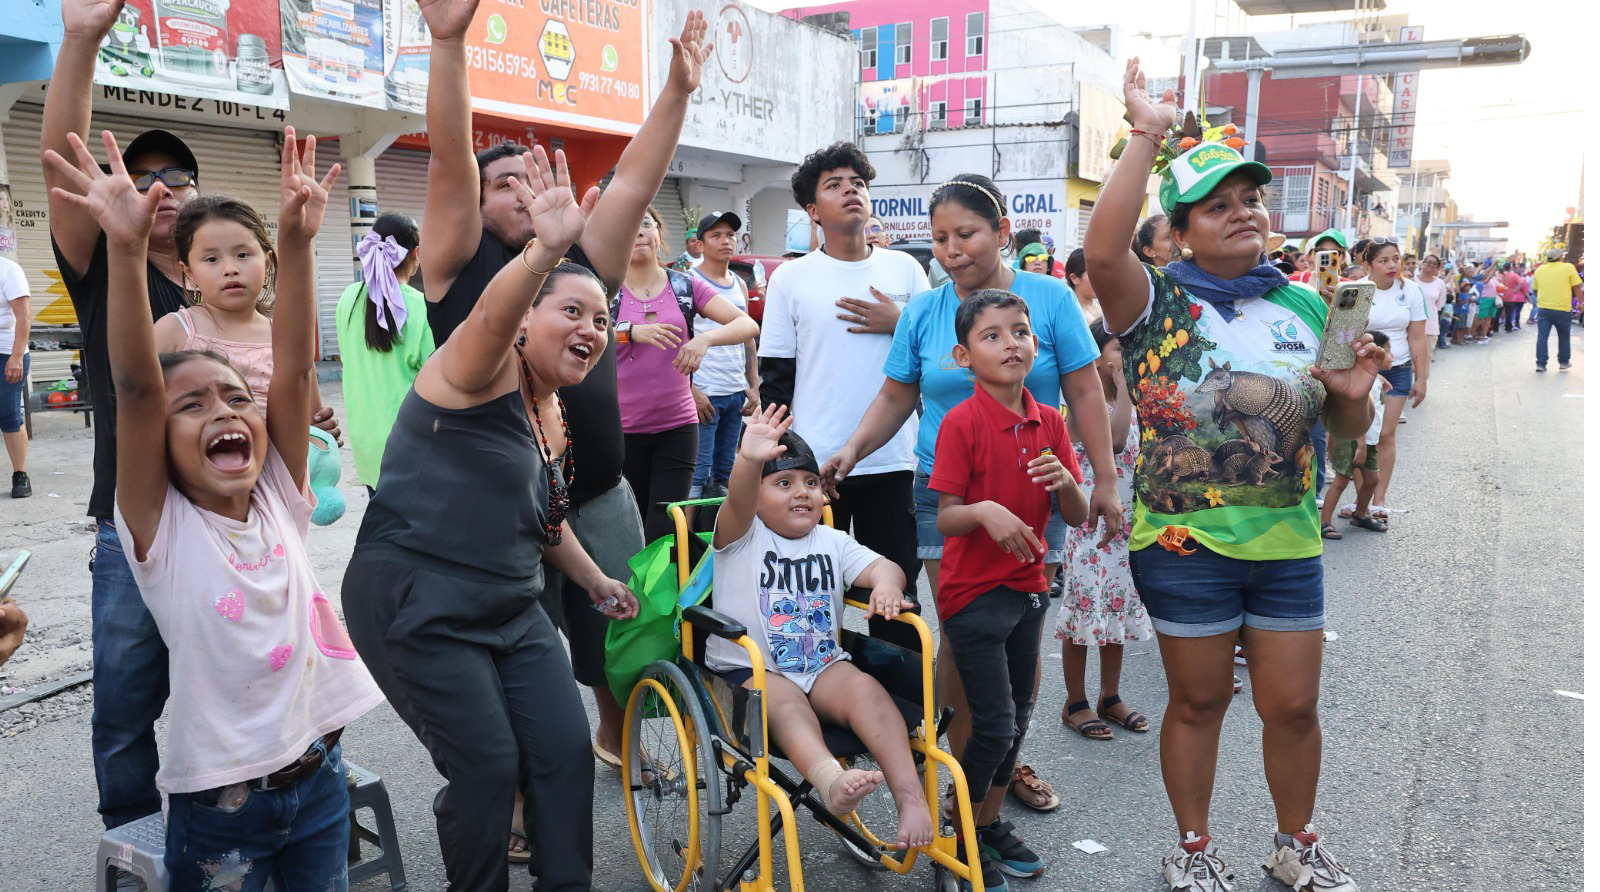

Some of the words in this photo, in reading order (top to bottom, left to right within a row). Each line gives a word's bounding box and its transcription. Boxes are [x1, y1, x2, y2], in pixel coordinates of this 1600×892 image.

[539, 0, 620, 32] CAFETERAS
[1396, 74, 1413, 148] CASION
[678, 161, 684, 172] 6
[16, 210, 46, 218] CREDITO
[871, 197, 928, 217] TORNIL
[1012, 193, 1062, 214] GRAL.
[884, 221, 916, 231] RNILLOS
[917, 221, 932, 231] GAL
[1015, 219, 1043, 229] GRADO
[1046, 219, 1052, 228] 8
